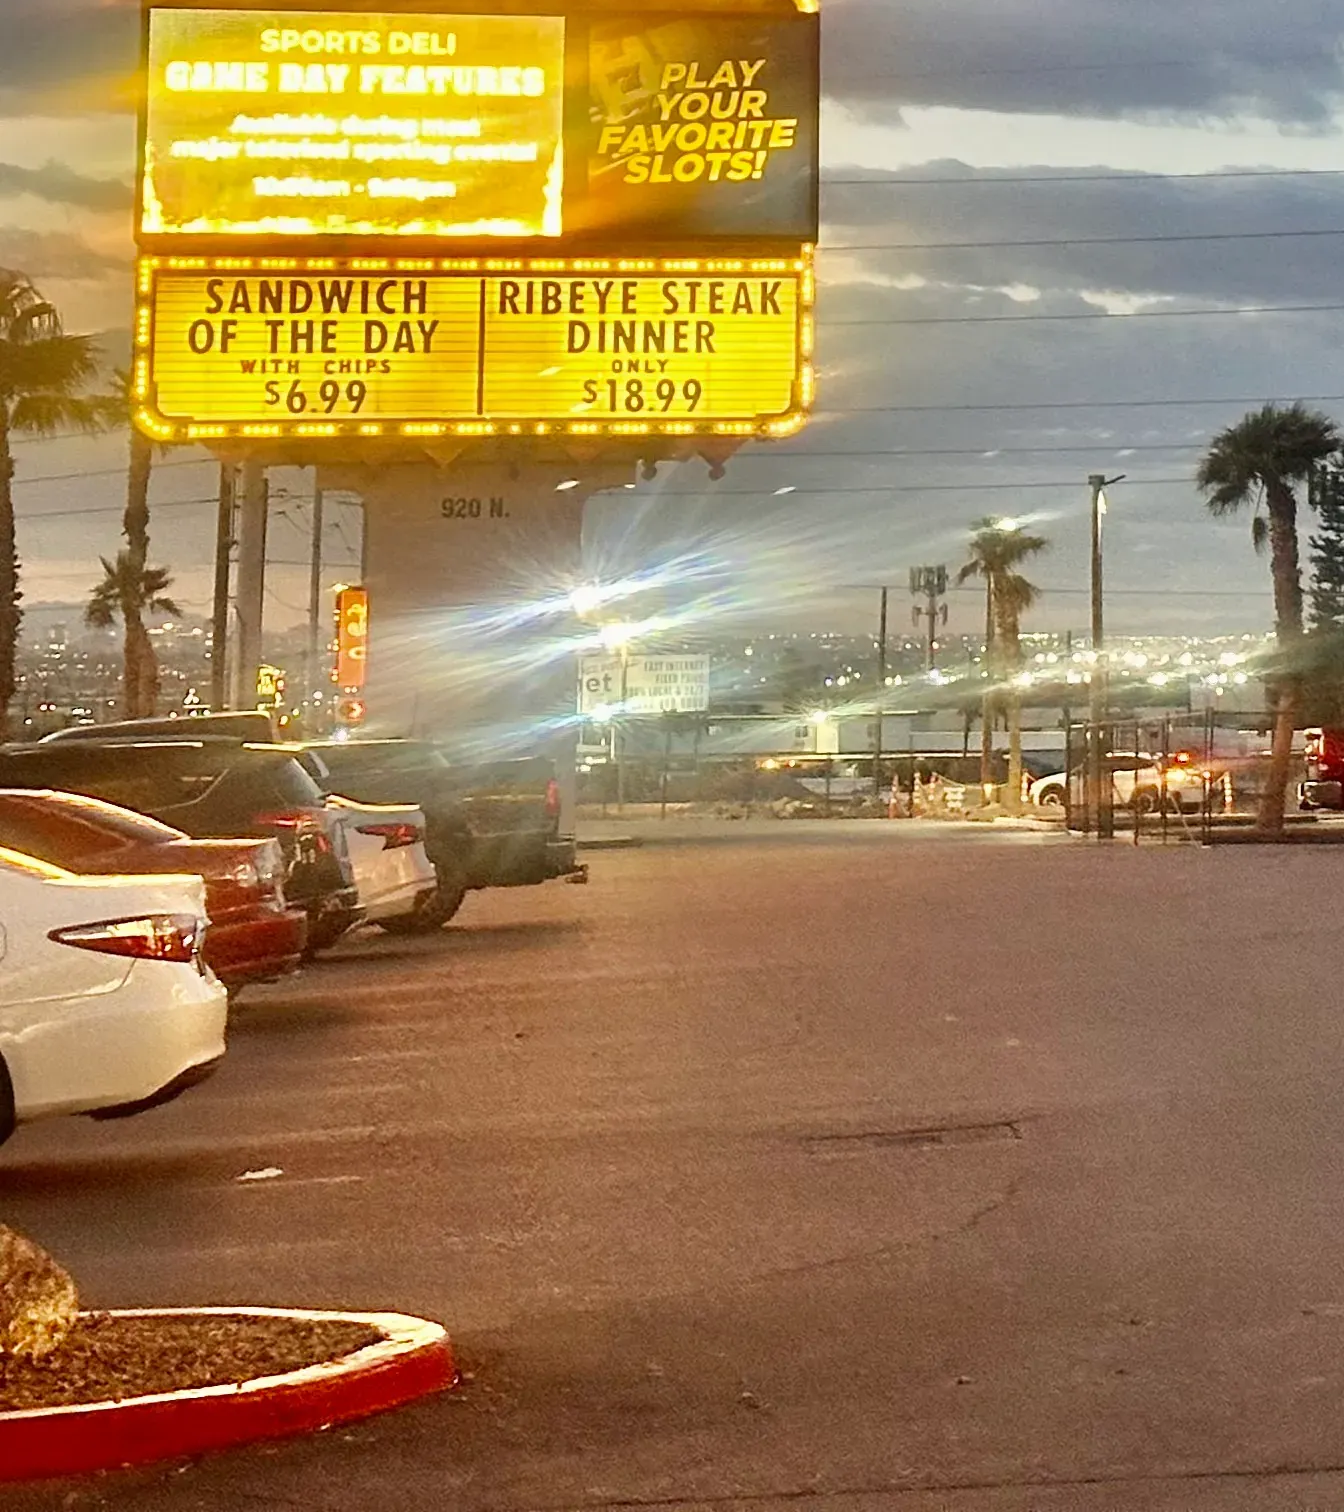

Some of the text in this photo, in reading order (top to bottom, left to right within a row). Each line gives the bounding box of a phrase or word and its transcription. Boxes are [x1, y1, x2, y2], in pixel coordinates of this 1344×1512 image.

[259, 28, 457, 57] SPORTS DELI
[165, 61, 545, 97] GAME DAY FEATURES
[659, 59, 767, 90] PLAY
[656, 90, 768, 121] YOUR
[597, 118, 798, 154] FAVORITE
[623, 150, 768, 184] SLOTS!
[204, 278, 428, 314] SANDWICH
[499, 280, 783, 315] RIBEYE STEAK
[188, 318, 440, 354] OF THE DAY
[566, 319, 717, 354] DINNER
[240, 358, 392, 375] WITH CHIPS
[611, 358, 670, 374] ONLY
[441, 497, 511, 519] 920 N.
